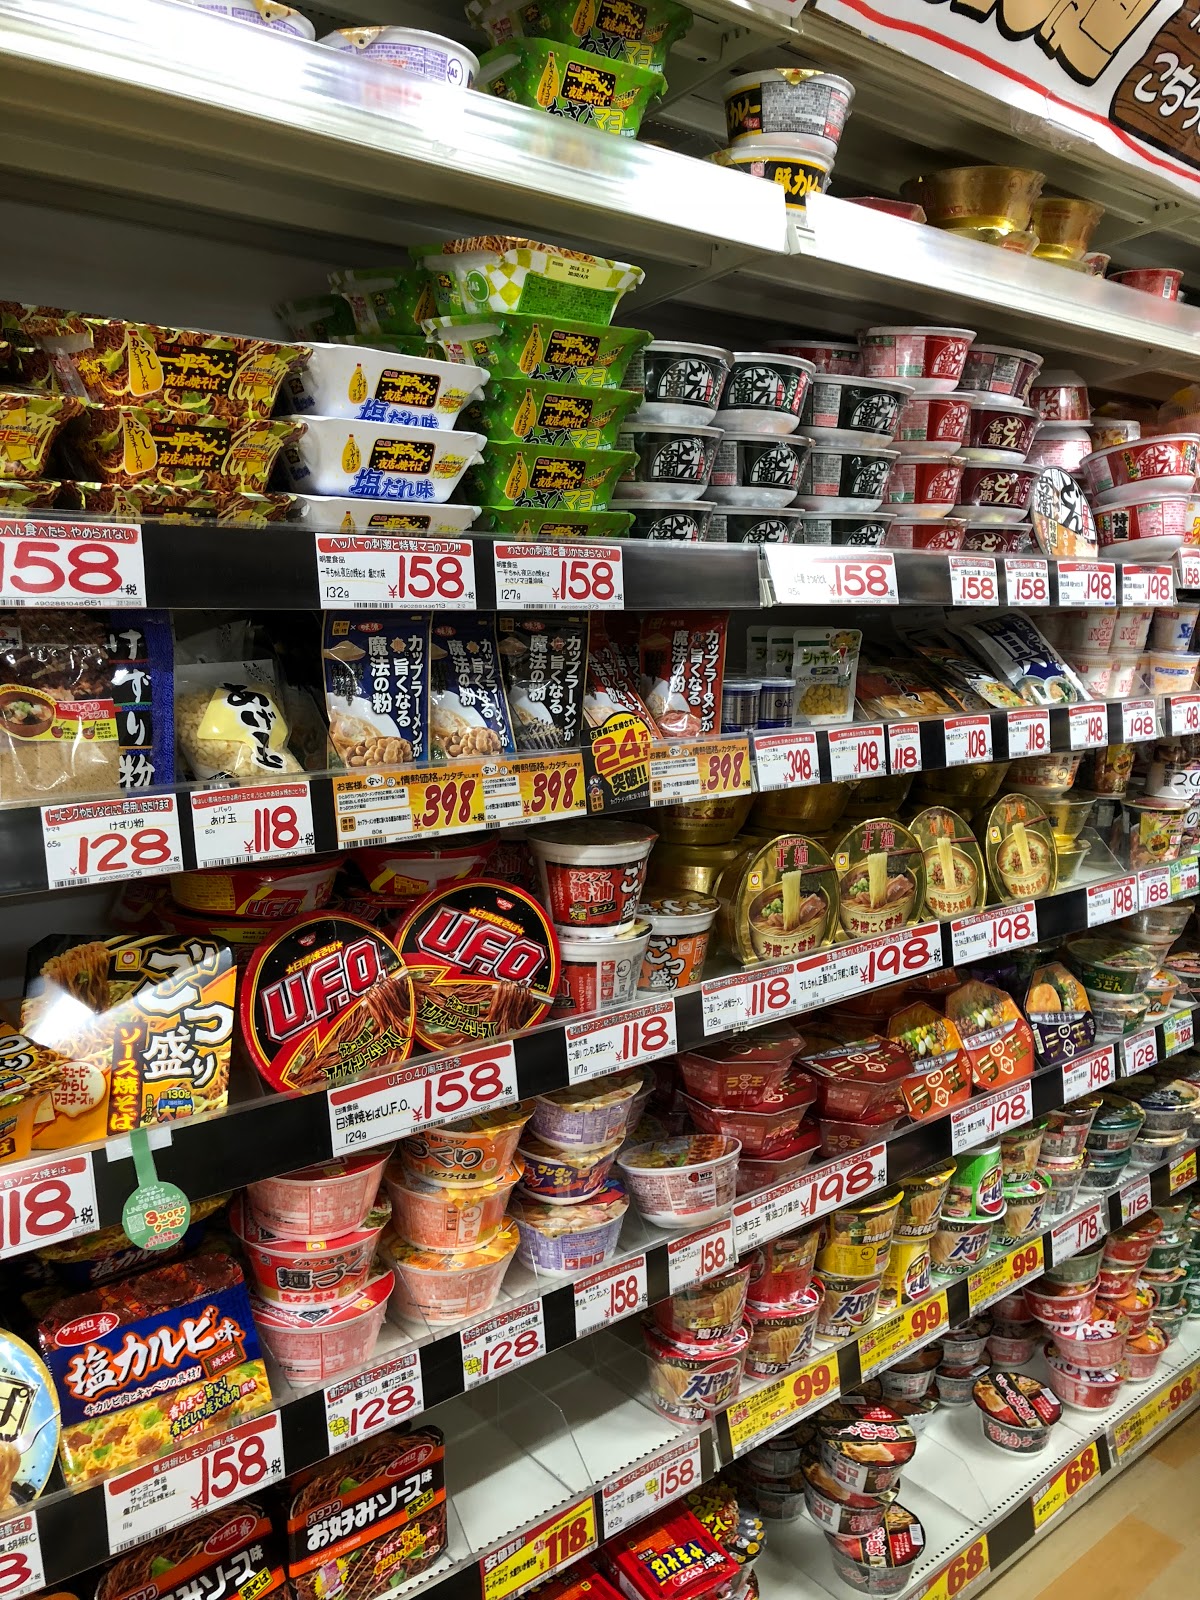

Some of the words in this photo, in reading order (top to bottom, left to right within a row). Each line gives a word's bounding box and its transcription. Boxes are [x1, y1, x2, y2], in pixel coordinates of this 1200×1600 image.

[350, 468, 436, 500] 塩だれ味
[0, 1166, 72, 1190] 盛ソース焼そば。
